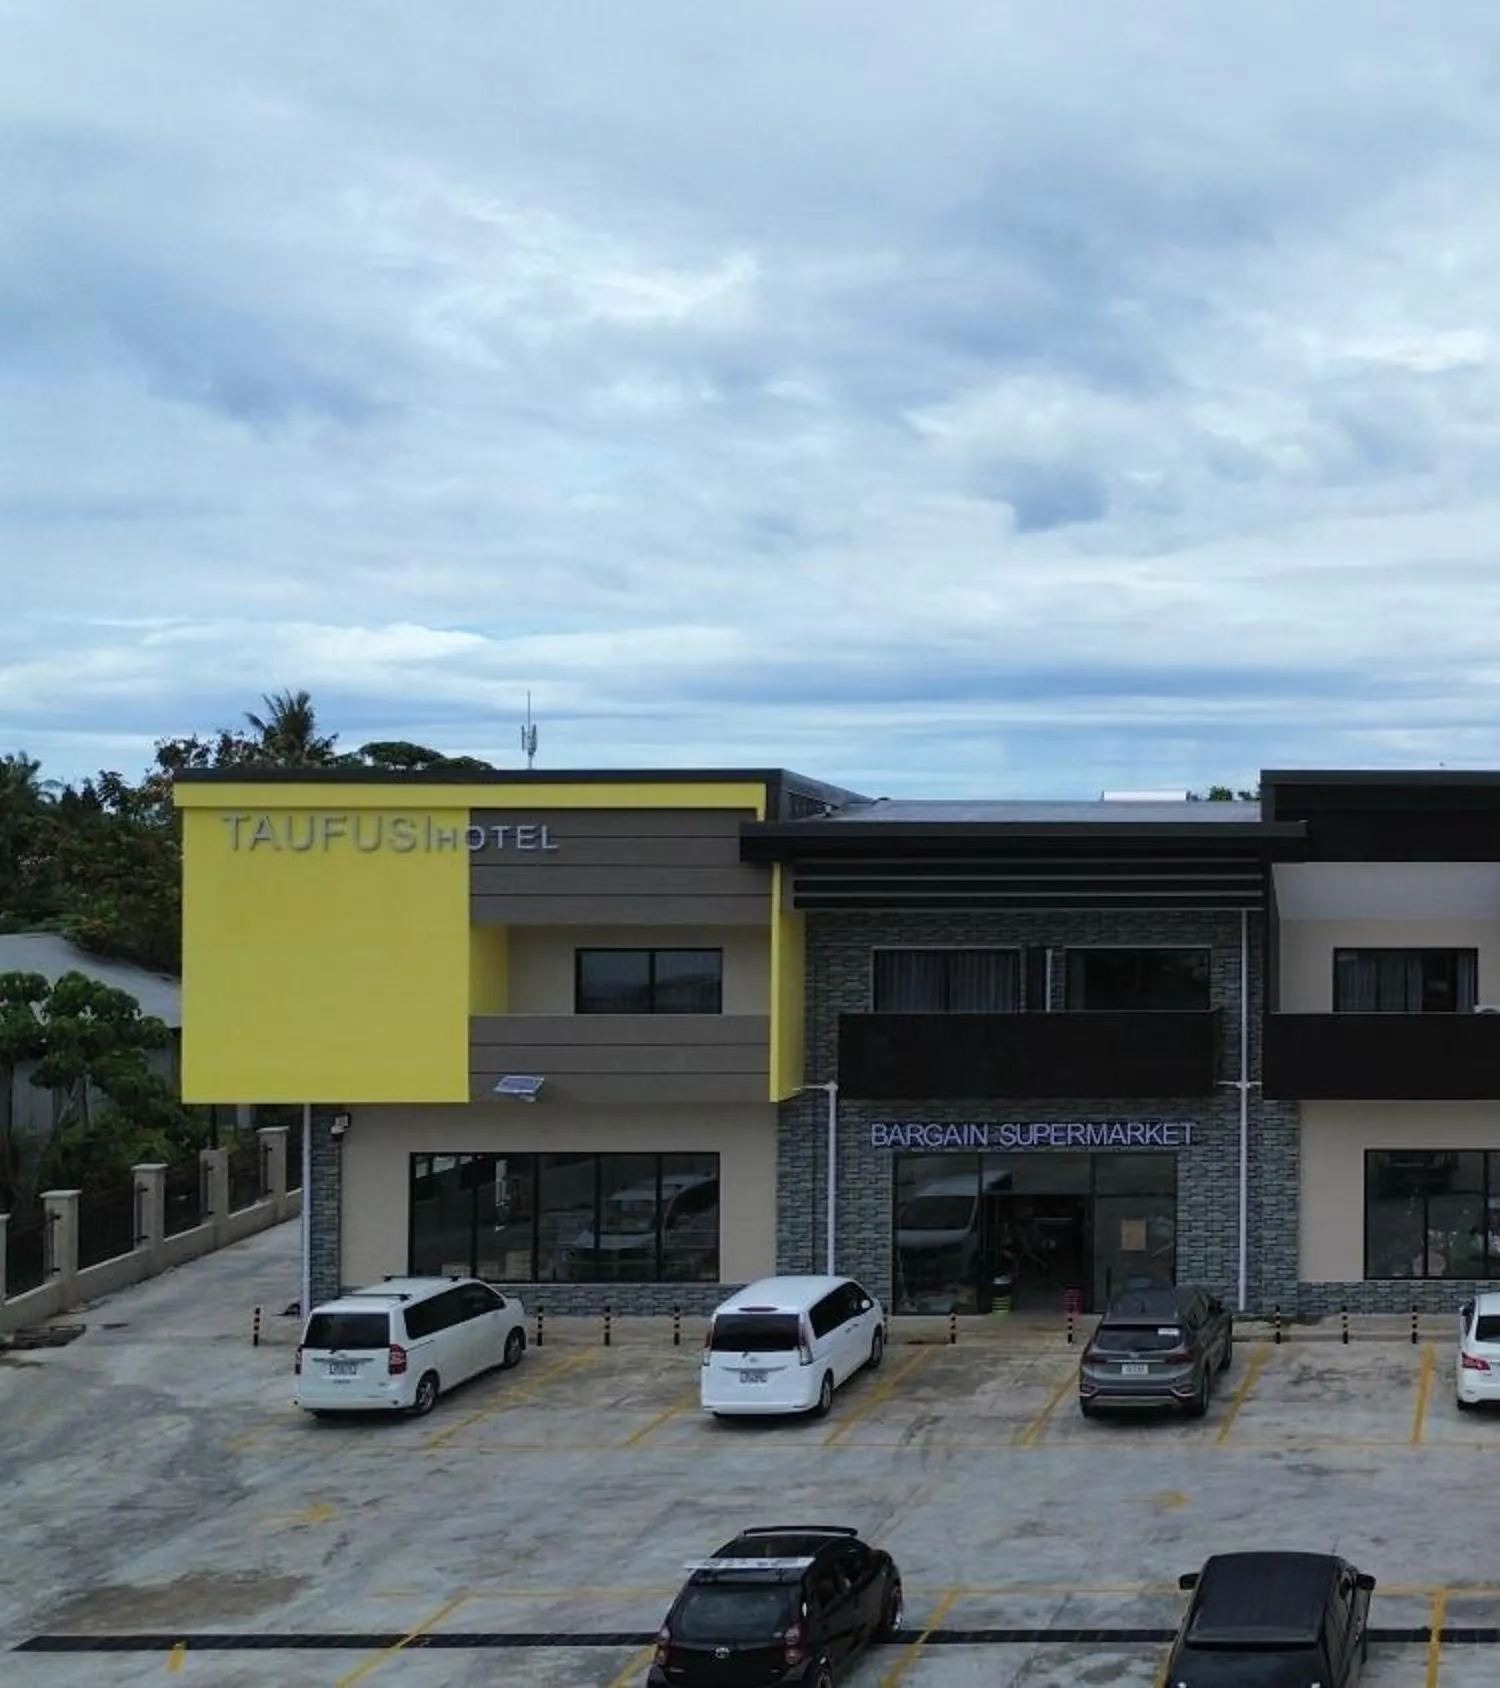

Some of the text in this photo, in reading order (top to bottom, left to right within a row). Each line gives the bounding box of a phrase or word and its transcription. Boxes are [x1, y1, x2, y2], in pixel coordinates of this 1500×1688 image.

[223, 814, 559, 853] TAUFUSI HOTEL
[870, 1122, 1197, 1146] BARGAIN SUPERMARKET
